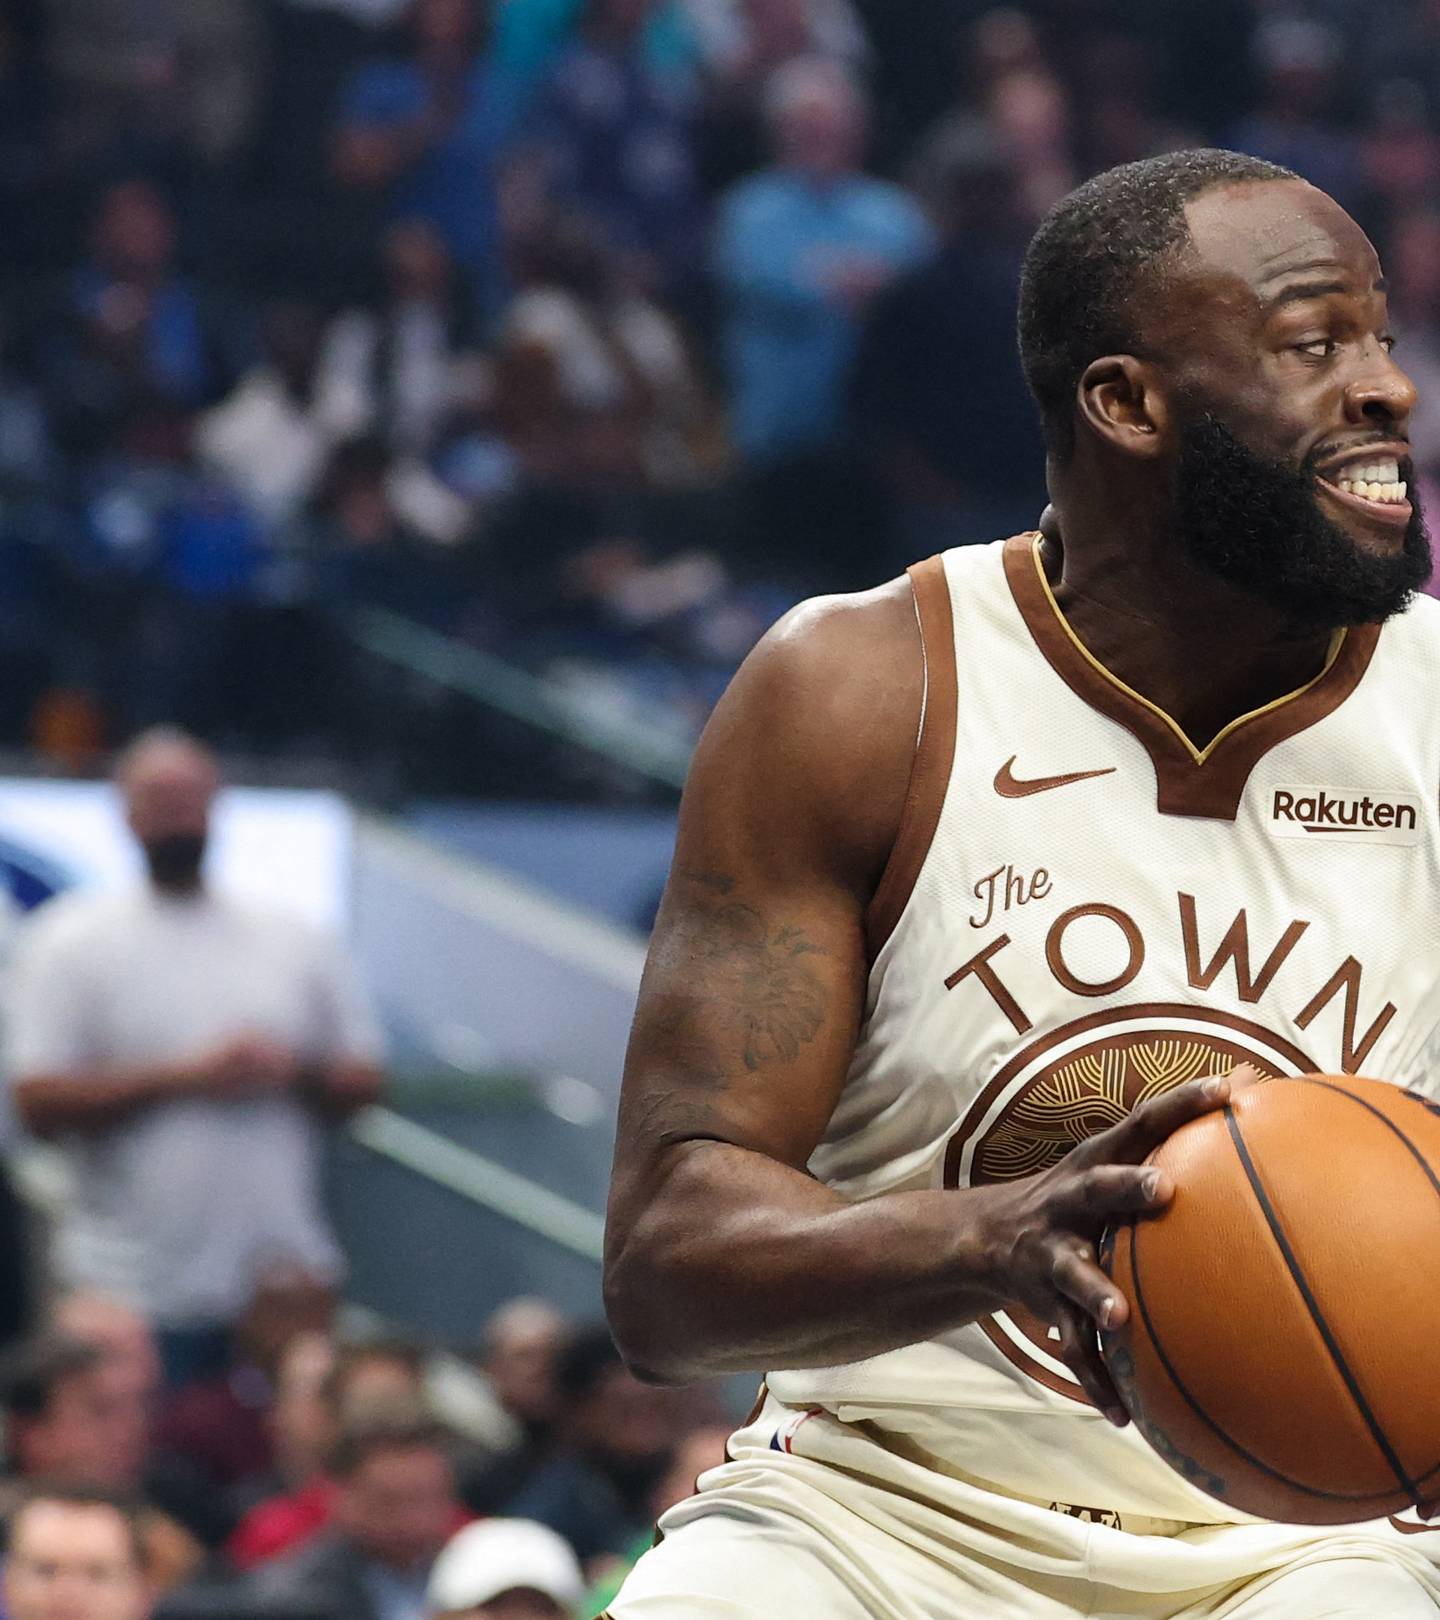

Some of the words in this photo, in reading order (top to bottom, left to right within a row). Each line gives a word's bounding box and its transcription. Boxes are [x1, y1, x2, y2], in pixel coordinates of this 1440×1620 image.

[1273, 790, 1417, 831] Rakuten
[969, 863, 1053, 930] The
[944, 890, 1397, 1076] TOWN
